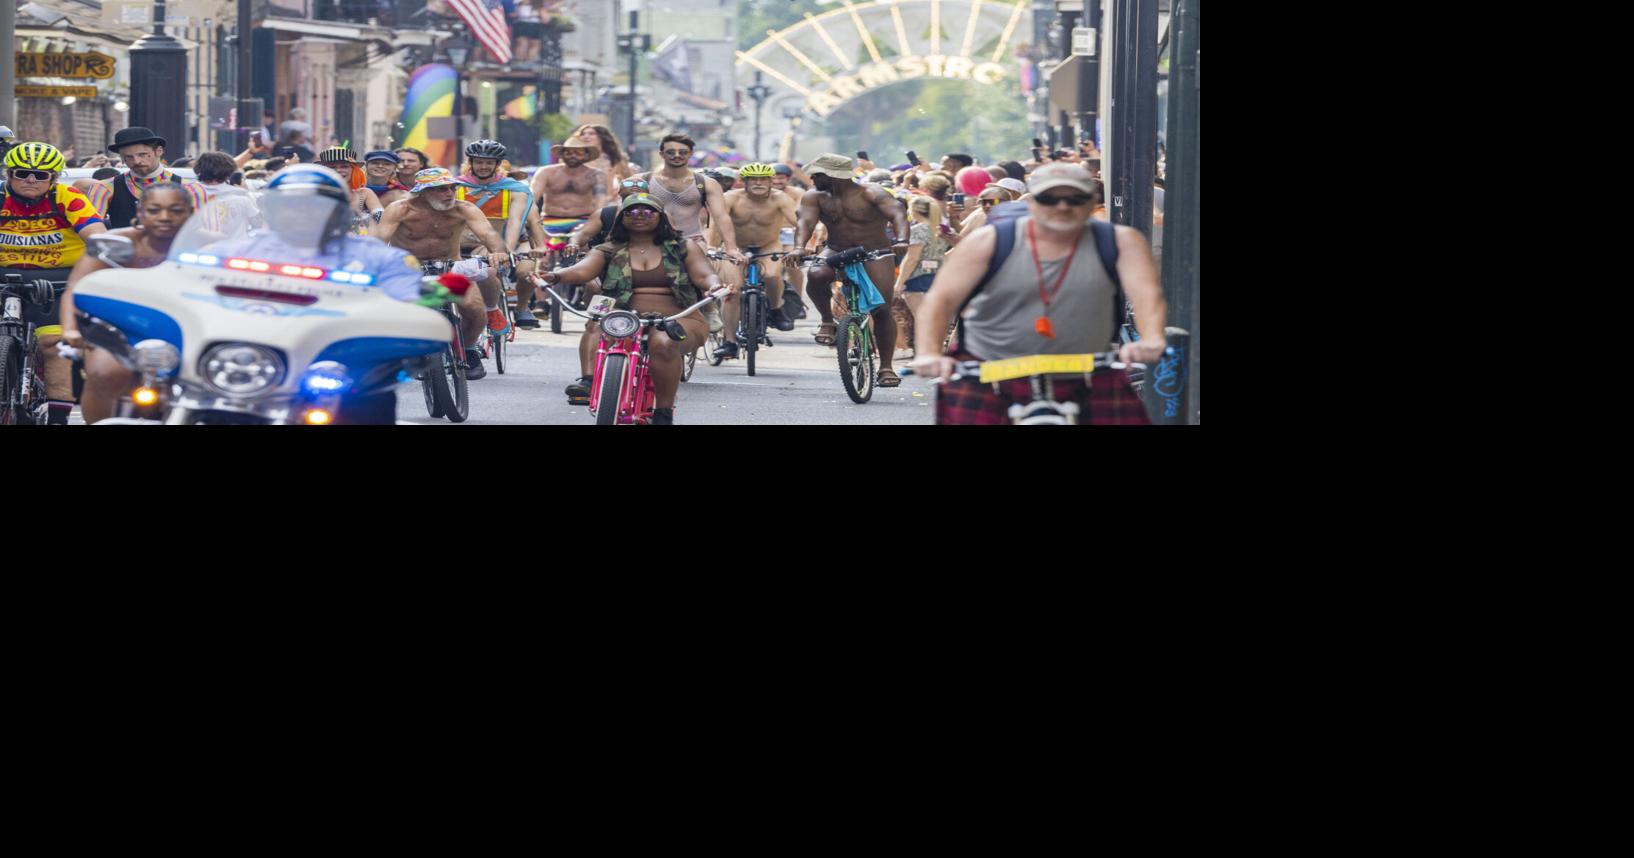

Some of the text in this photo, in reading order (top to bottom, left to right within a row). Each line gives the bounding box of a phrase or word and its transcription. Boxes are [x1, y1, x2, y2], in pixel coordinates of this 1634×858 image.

[42, 55, 82, 75] SHOP
[51, 87, 58, 95] &
[63, 87, 93, 95] VAPE
